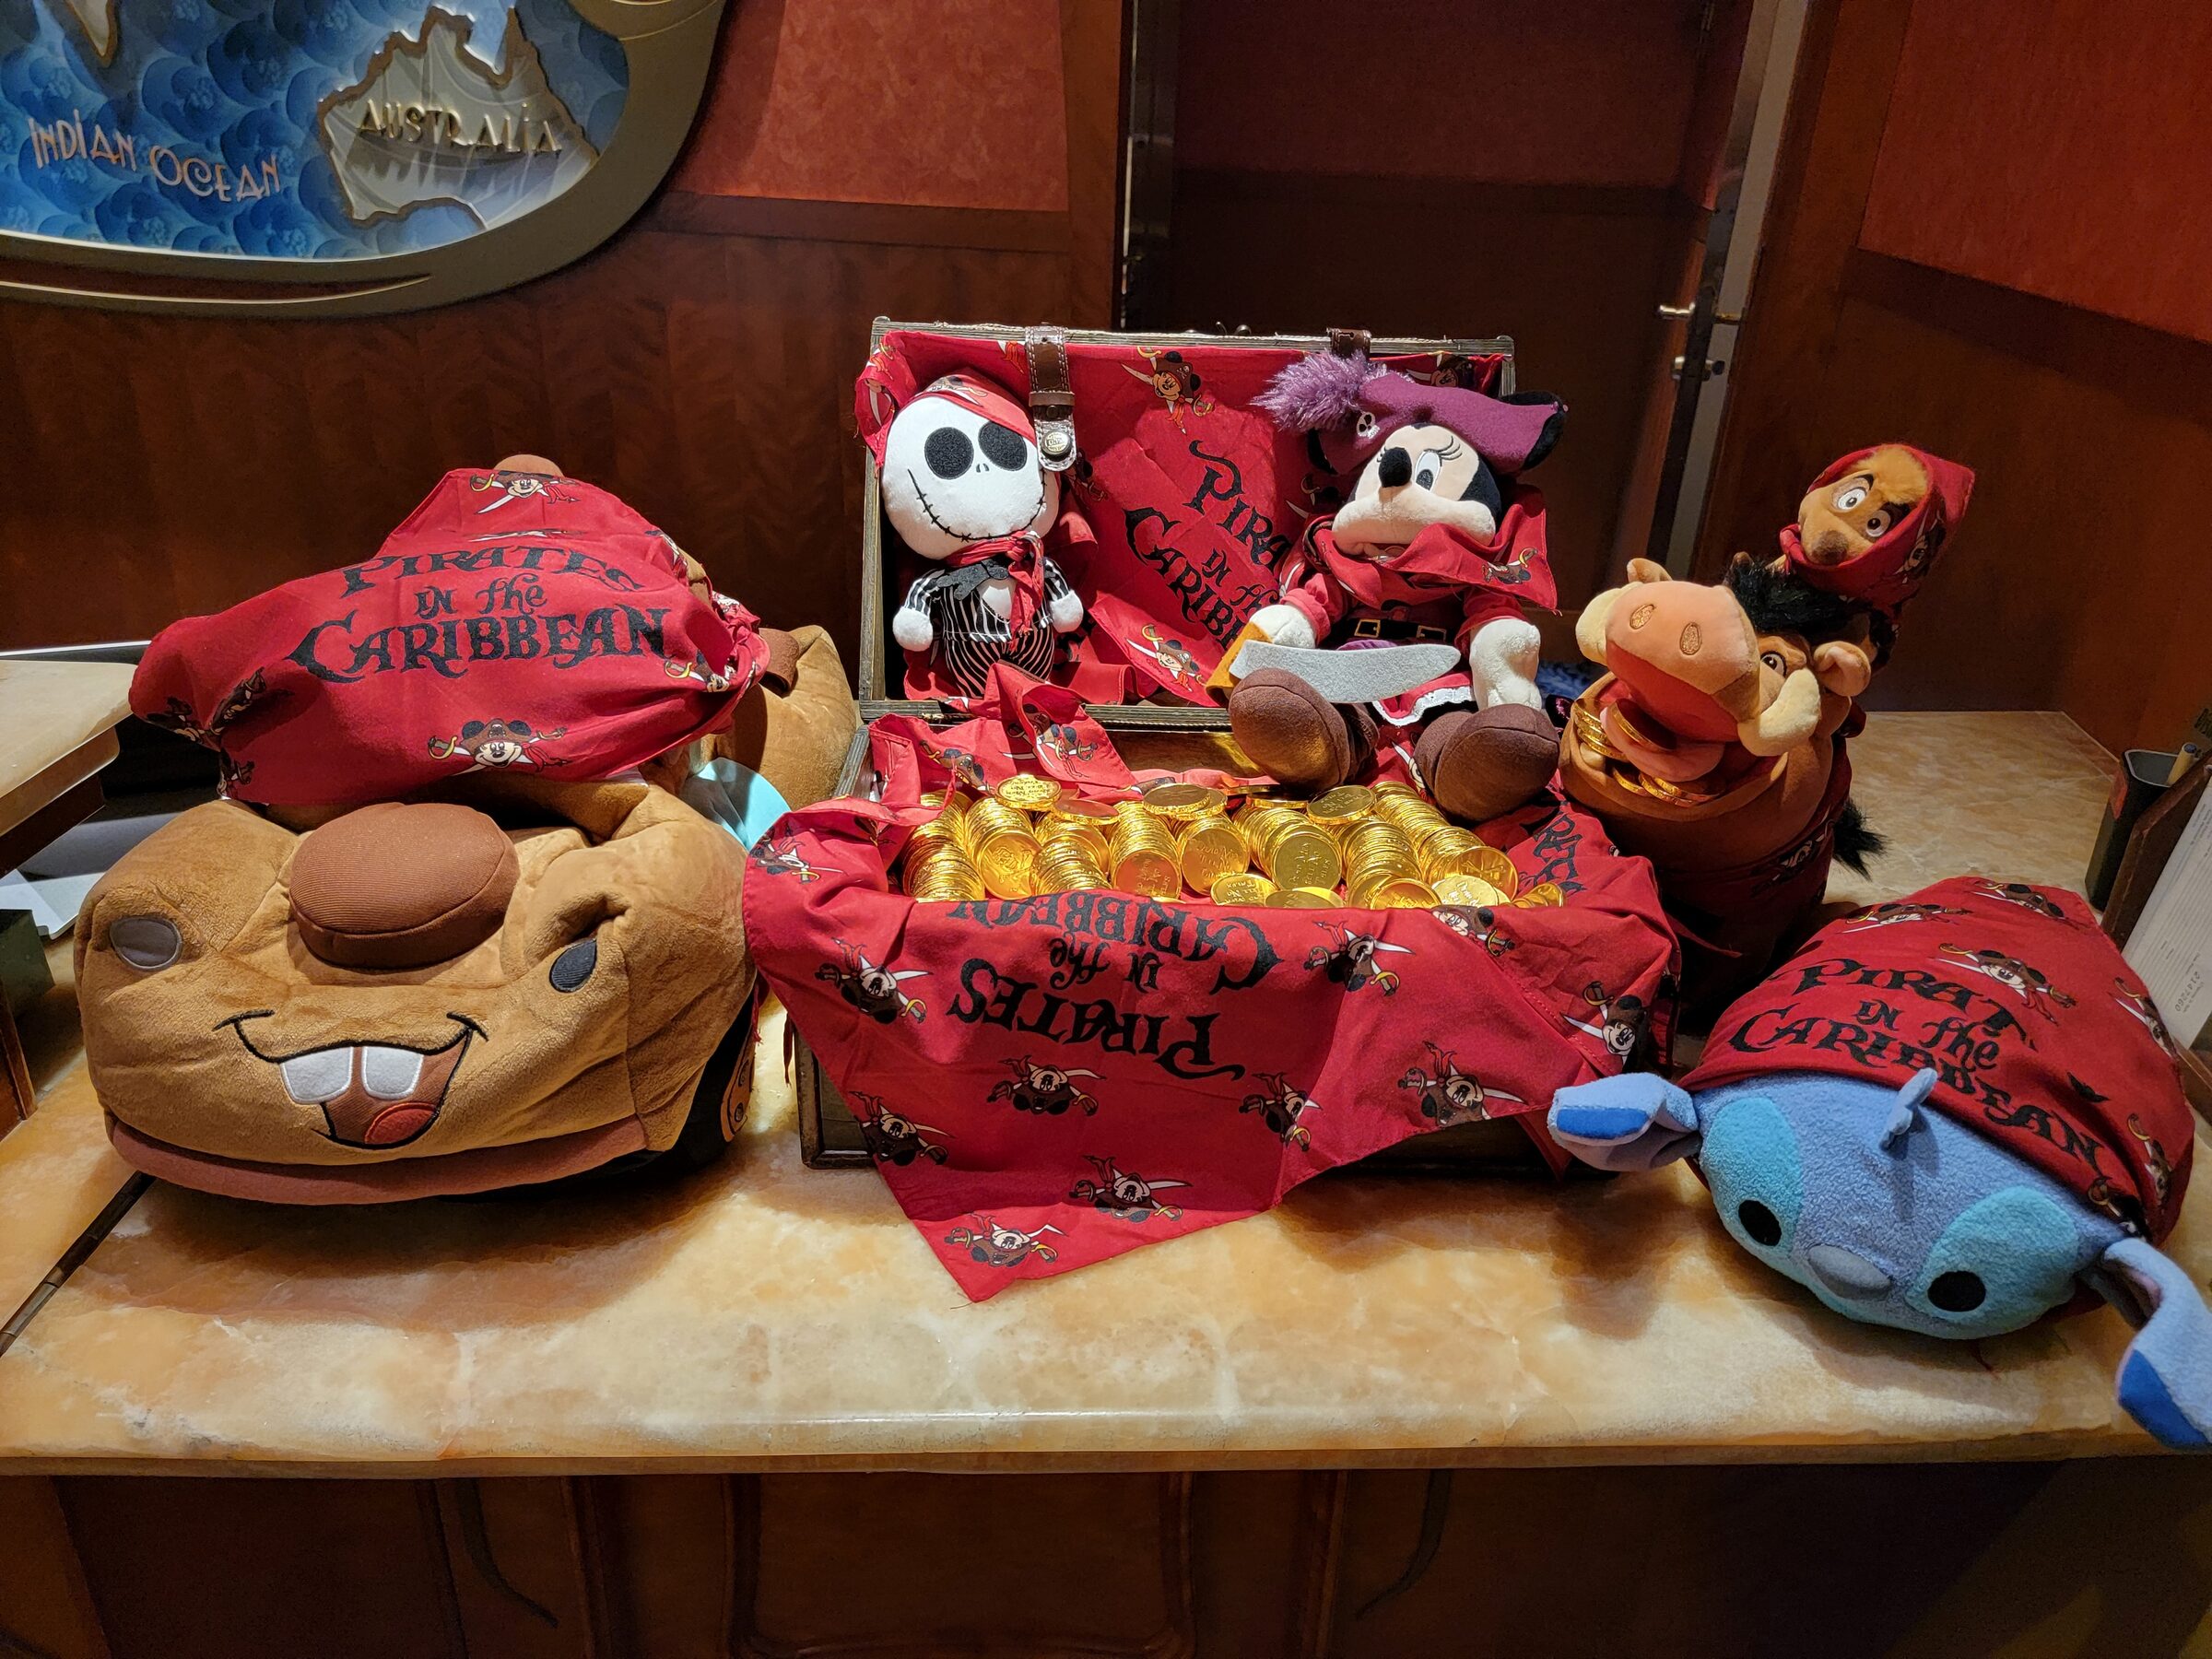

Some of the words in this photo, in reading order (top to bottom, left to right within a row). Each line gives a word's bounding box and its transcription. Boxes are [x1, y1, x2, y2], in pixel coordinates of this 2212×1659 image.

[28, 108, 137, 171] INDIAN
[149, 145, 280, 202] OCEAN
[357, 99, 561, 159] AUSTRALIA
[1182, 440, 1293, 576] PIRA
[339, 545, 646, 599] PIRATES
[283, 603, 673, 684] CARIBBEAN
[946, 958, 1246, 1082] PIRATES
[1767, 958, 2030, 1045] PIRAT
